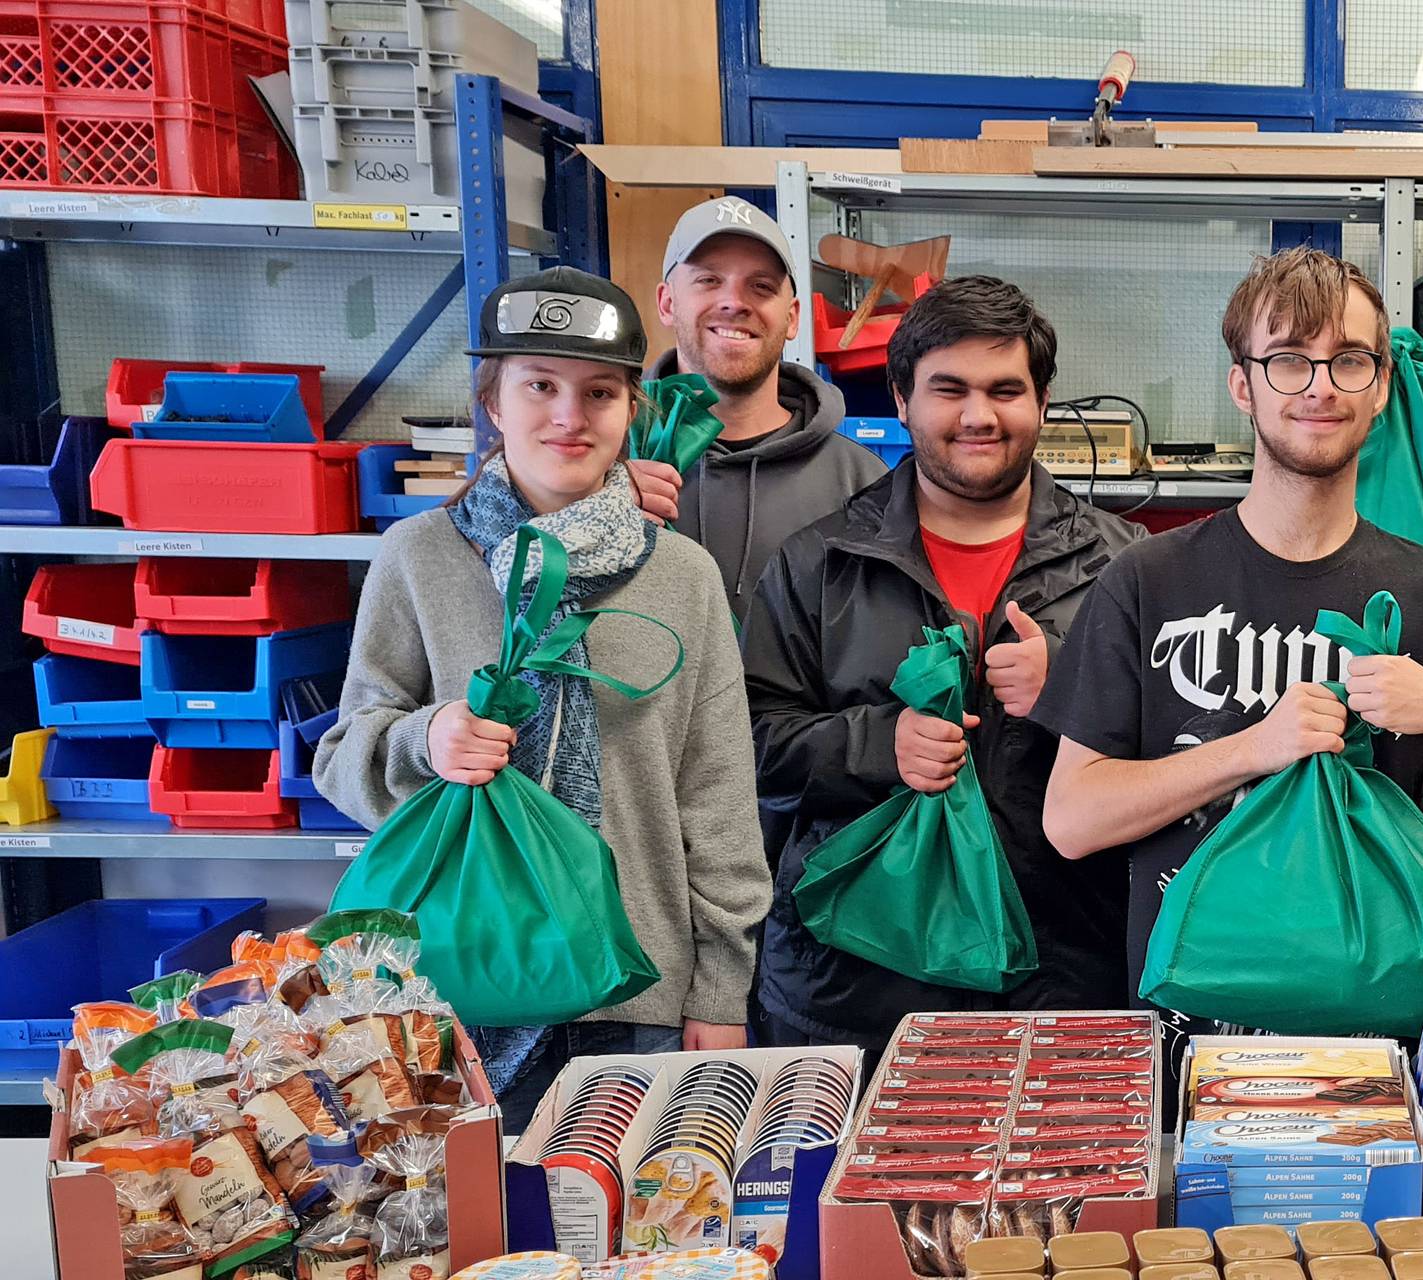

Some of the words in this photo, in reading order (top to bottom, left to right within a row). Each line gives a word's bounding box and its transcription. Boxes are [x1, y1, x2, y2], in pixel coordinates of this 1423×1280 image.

[354, 160, 411, 183] Kabel
[832, 172, 892, 190] Schweißgerät
[28, 204, 55, 214] Leere
[57, 203, 87, 213] Kisten
[317, 210, 337, 219] Max.
[338, 210, 372, 220] Fachlast
[395, 213, 404, 222] kg
[135, 542, 160, 551] Leere
[163, 542, 191, 551] Kisten
[8, 839, 36, 847] Kisten
[1216, 1051, 1312, 1063] Choceur
[1224, 1080, 1320, 1091] Choceur
[1224, 1111, 1325, 1121] Choceur
[1214, 1124, 1320, 1137] Choceur
[1203, 1153, 1234, 1163] Choceur
[1264, 1154, 1287, 1162] ALPEN
[1289, 1154, 1313, 1162] SAHNE
[1342, 1154, 1360, 1163] 200g
[1265, 1173, 1289, 1181] ALPEN
[1291, 1173, 1315, 1181] SAHNE
[1343, 1173, 1362, 1182] 200g
[199, 1179, 245, 1210] Mandeln
[736, 1181, 790, 1197] HERINGS
[1264, 1192, 1288, 1200] ALPEN
[1289, 1192, 1313, 1200] SAHNE
[1341, 1192, 1360, 1201] 200g
[1263, 1211, 1287, 1219] ALPEN
[1288, 1211, 1312, 1219] SAHNE
[1340, 1211, 1360, 1219] 200g
